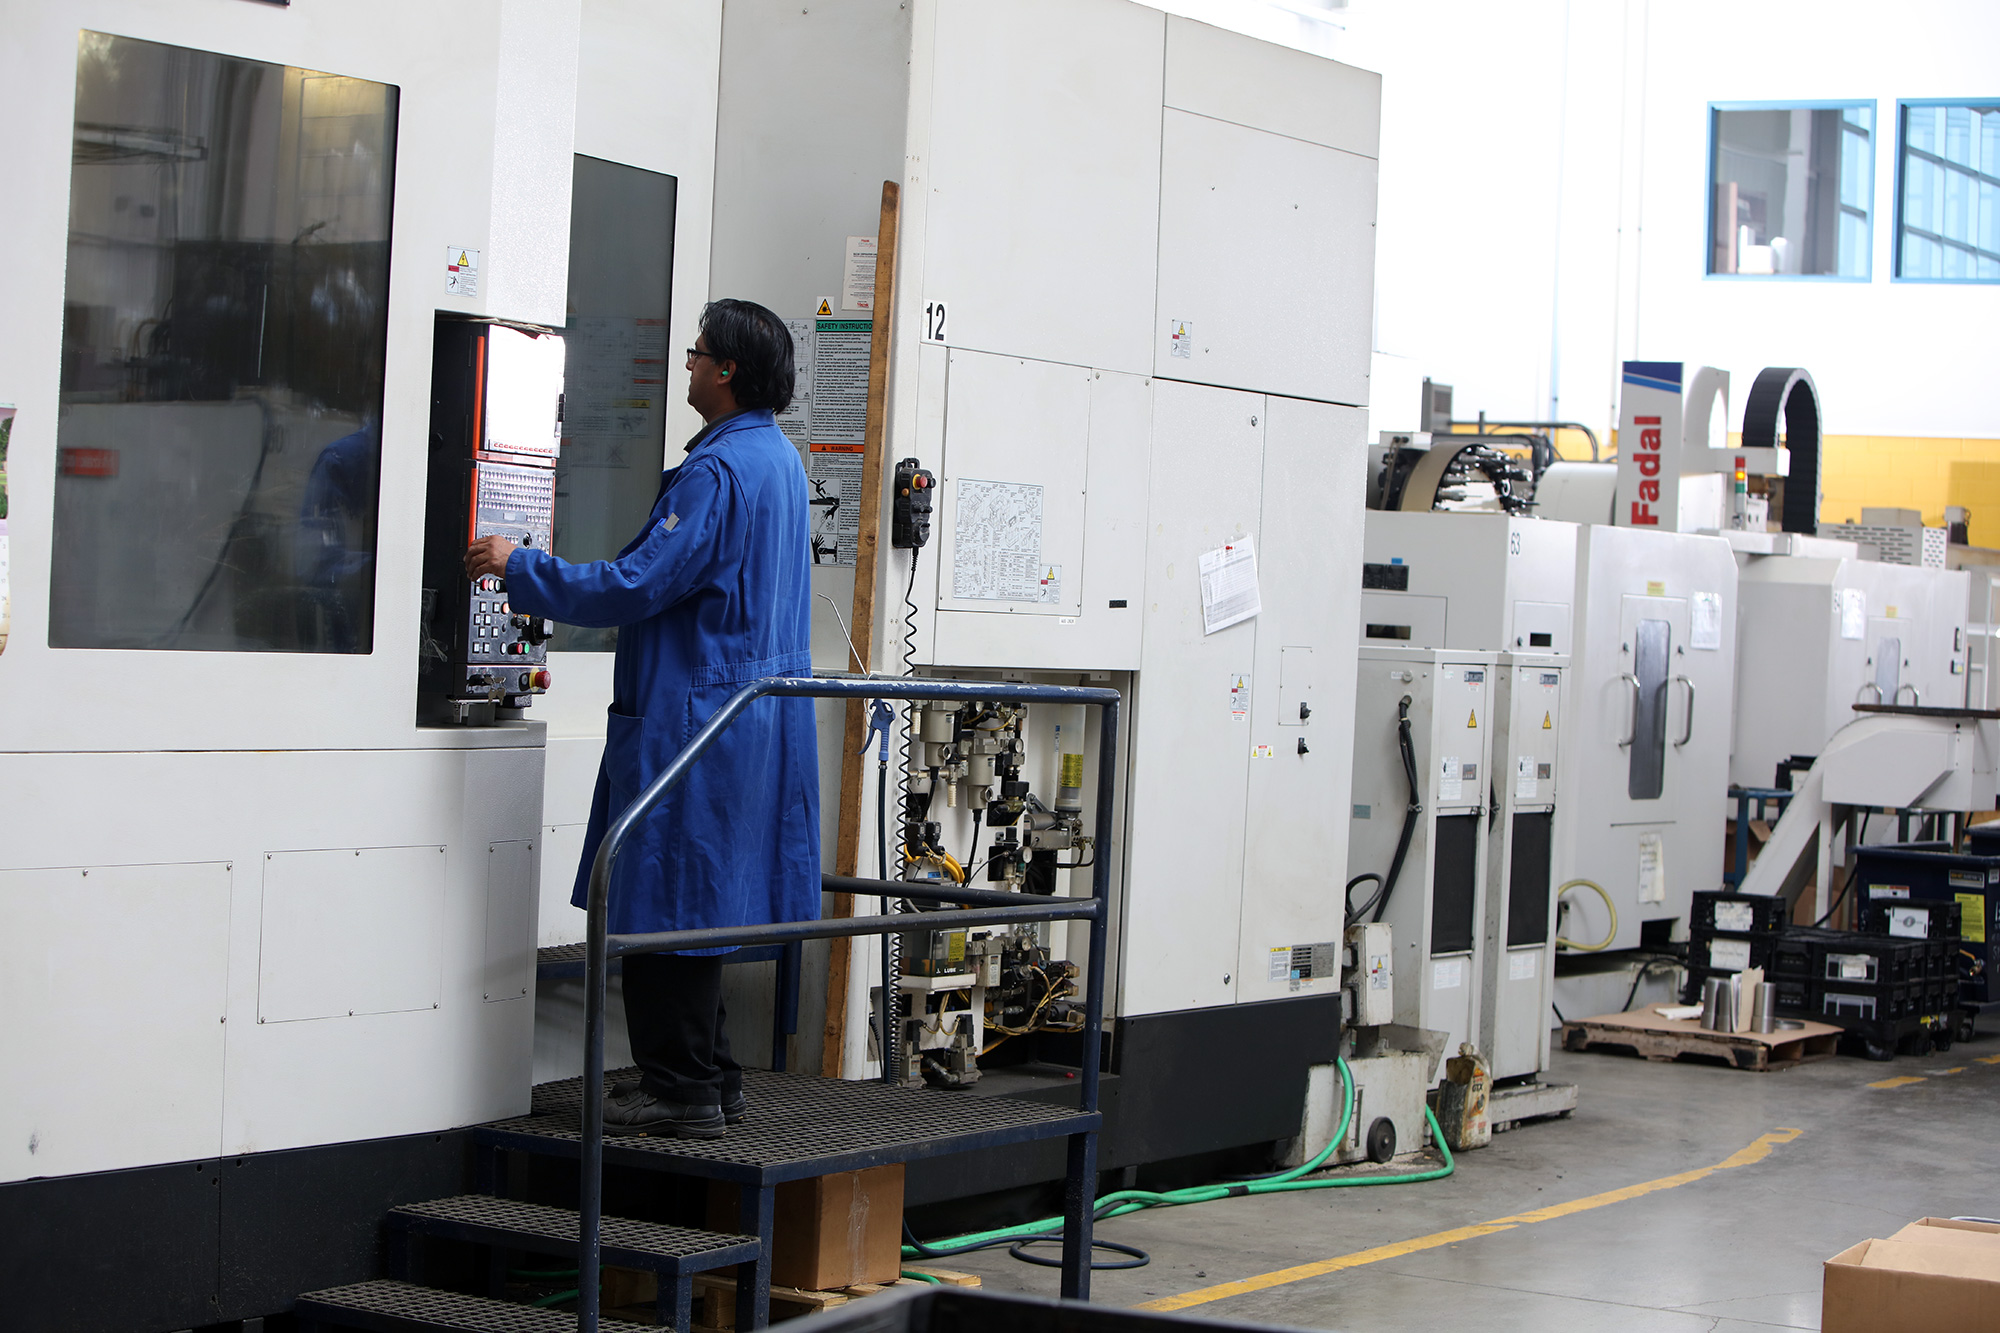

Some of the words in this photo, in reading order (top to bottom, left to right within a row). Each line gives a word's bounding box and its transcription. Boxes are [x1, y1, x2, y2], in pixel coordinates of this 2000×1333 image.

[926, 302, 945, 341] 12
[1631, 416, 1662, 525] Fadal
[1510, 531, 1521, 555] 63
